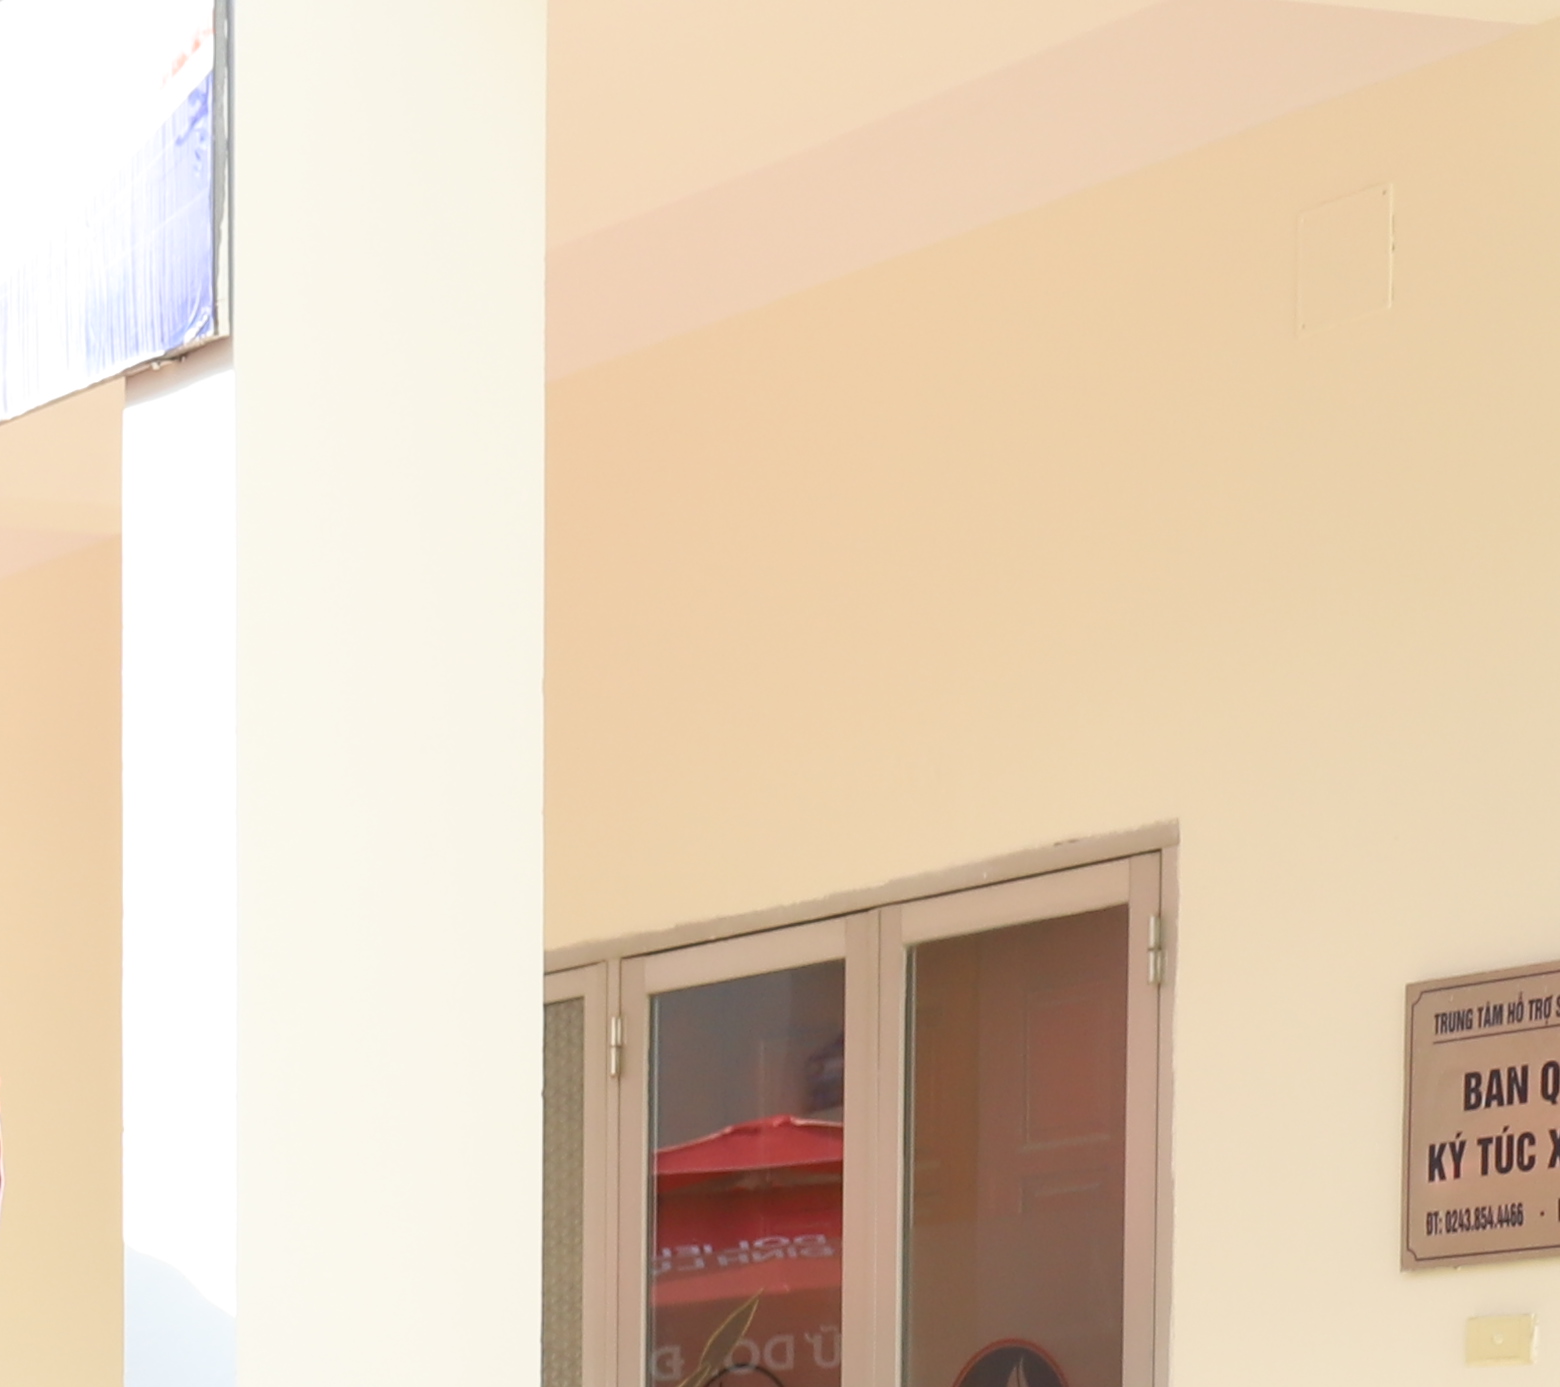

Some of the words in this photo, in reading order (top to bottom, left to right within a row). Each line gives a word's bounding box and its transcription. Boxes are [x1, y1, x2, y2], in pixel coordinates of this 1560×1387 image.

[1434, 1008, 1474, 1035] TRUNG
[1477, 1002, 1504, 1029] TÂM
[1528, 994, 1555, 1025] TRỢ
[1464, 1064, 1529, 1111] BAN
[1428, 1132, 1467, 1183] KÝ
[1477, 1126, 1536, 1176] TÚC
[1426, 1209, 1442, 1236] ĐT:
